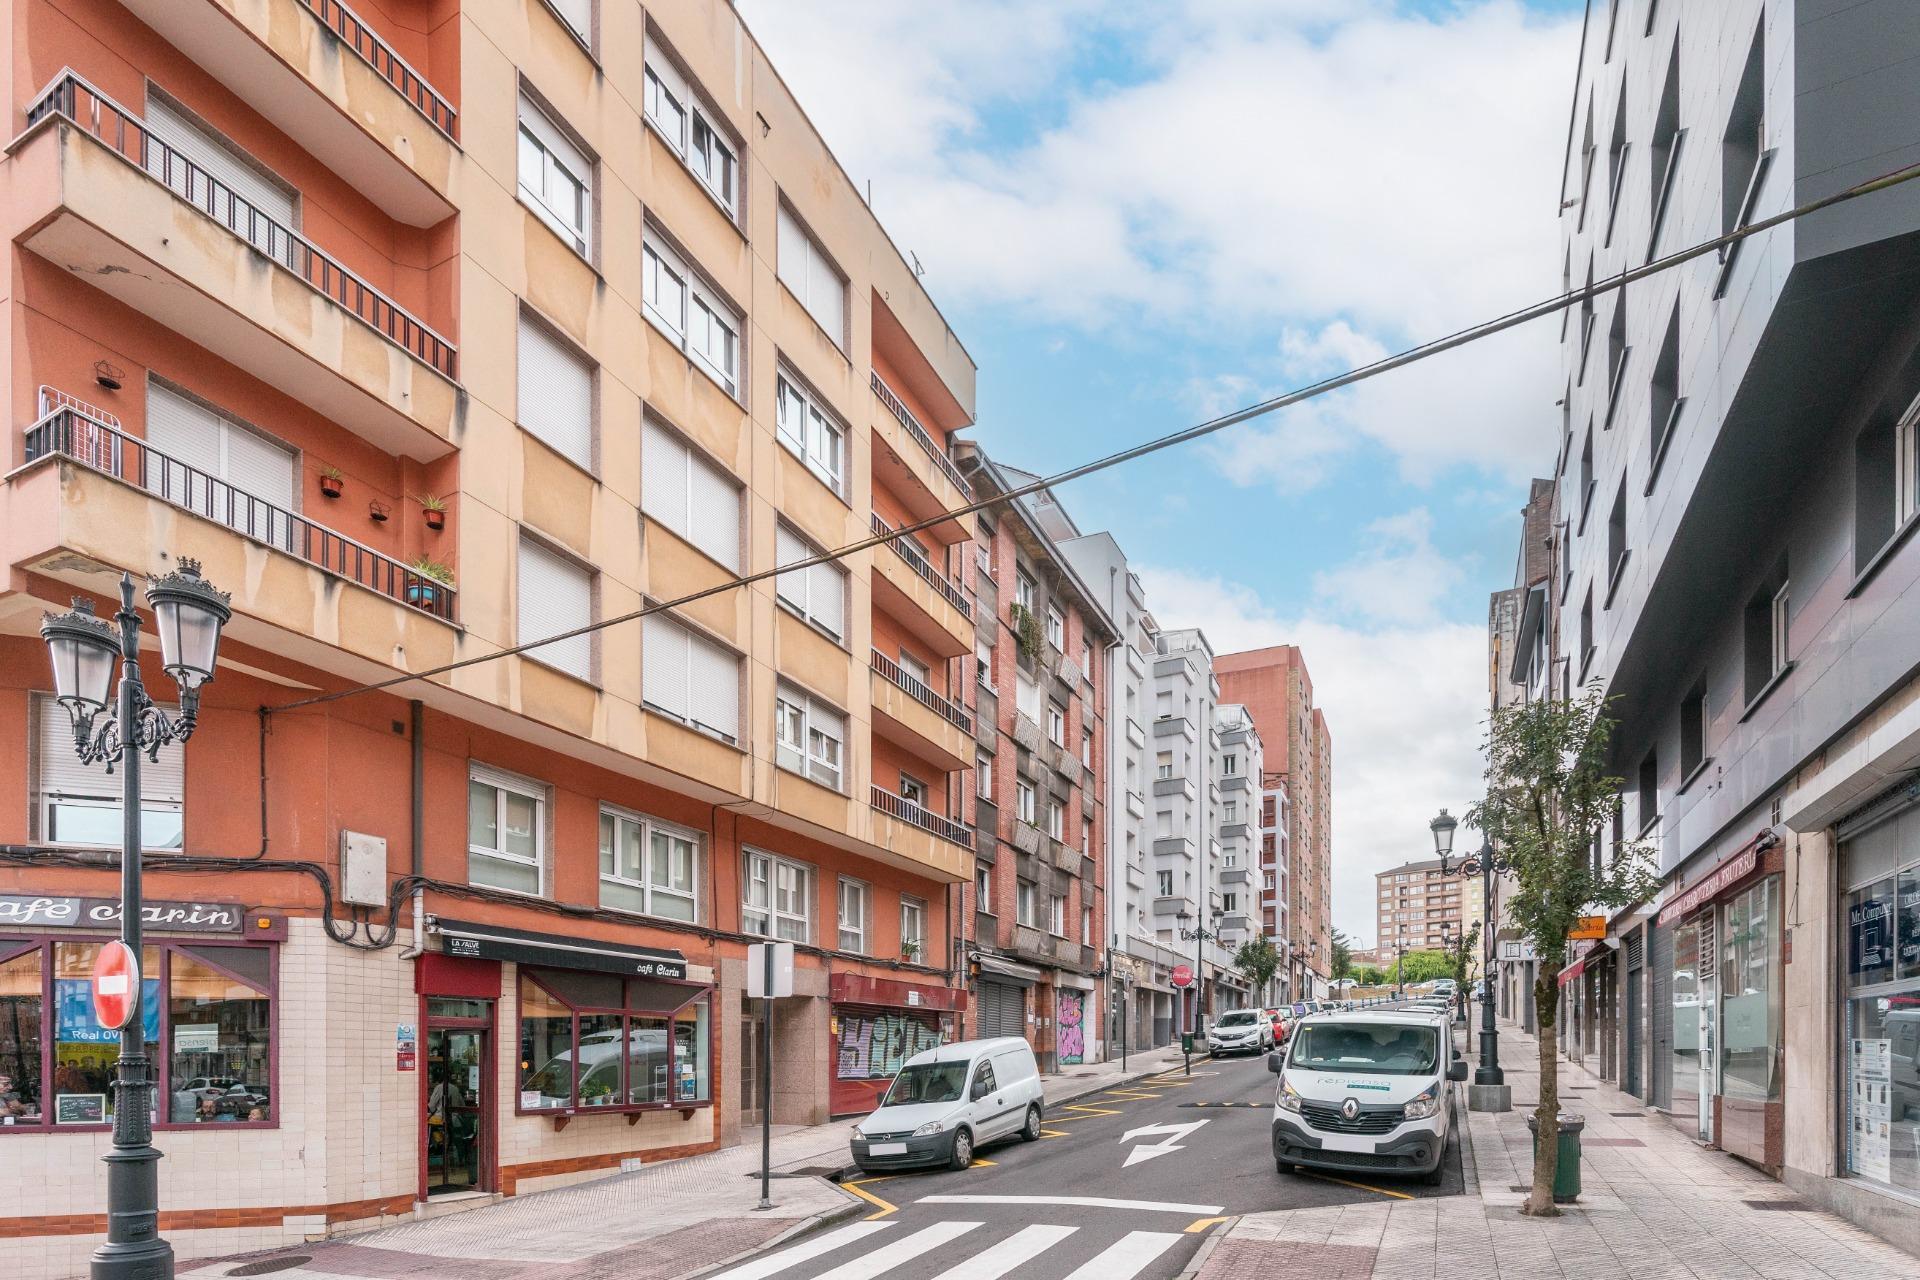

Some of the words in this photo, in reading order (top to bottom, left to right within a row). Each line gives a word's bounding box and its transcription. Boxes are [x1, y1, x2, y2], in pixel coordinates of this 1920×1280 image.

[0, 898, 72, 923] afé
[1852, 911, 1861, 924] Mr.
[637, 964, 653, 975] café
[72, 1031, 99, 1040] Real
